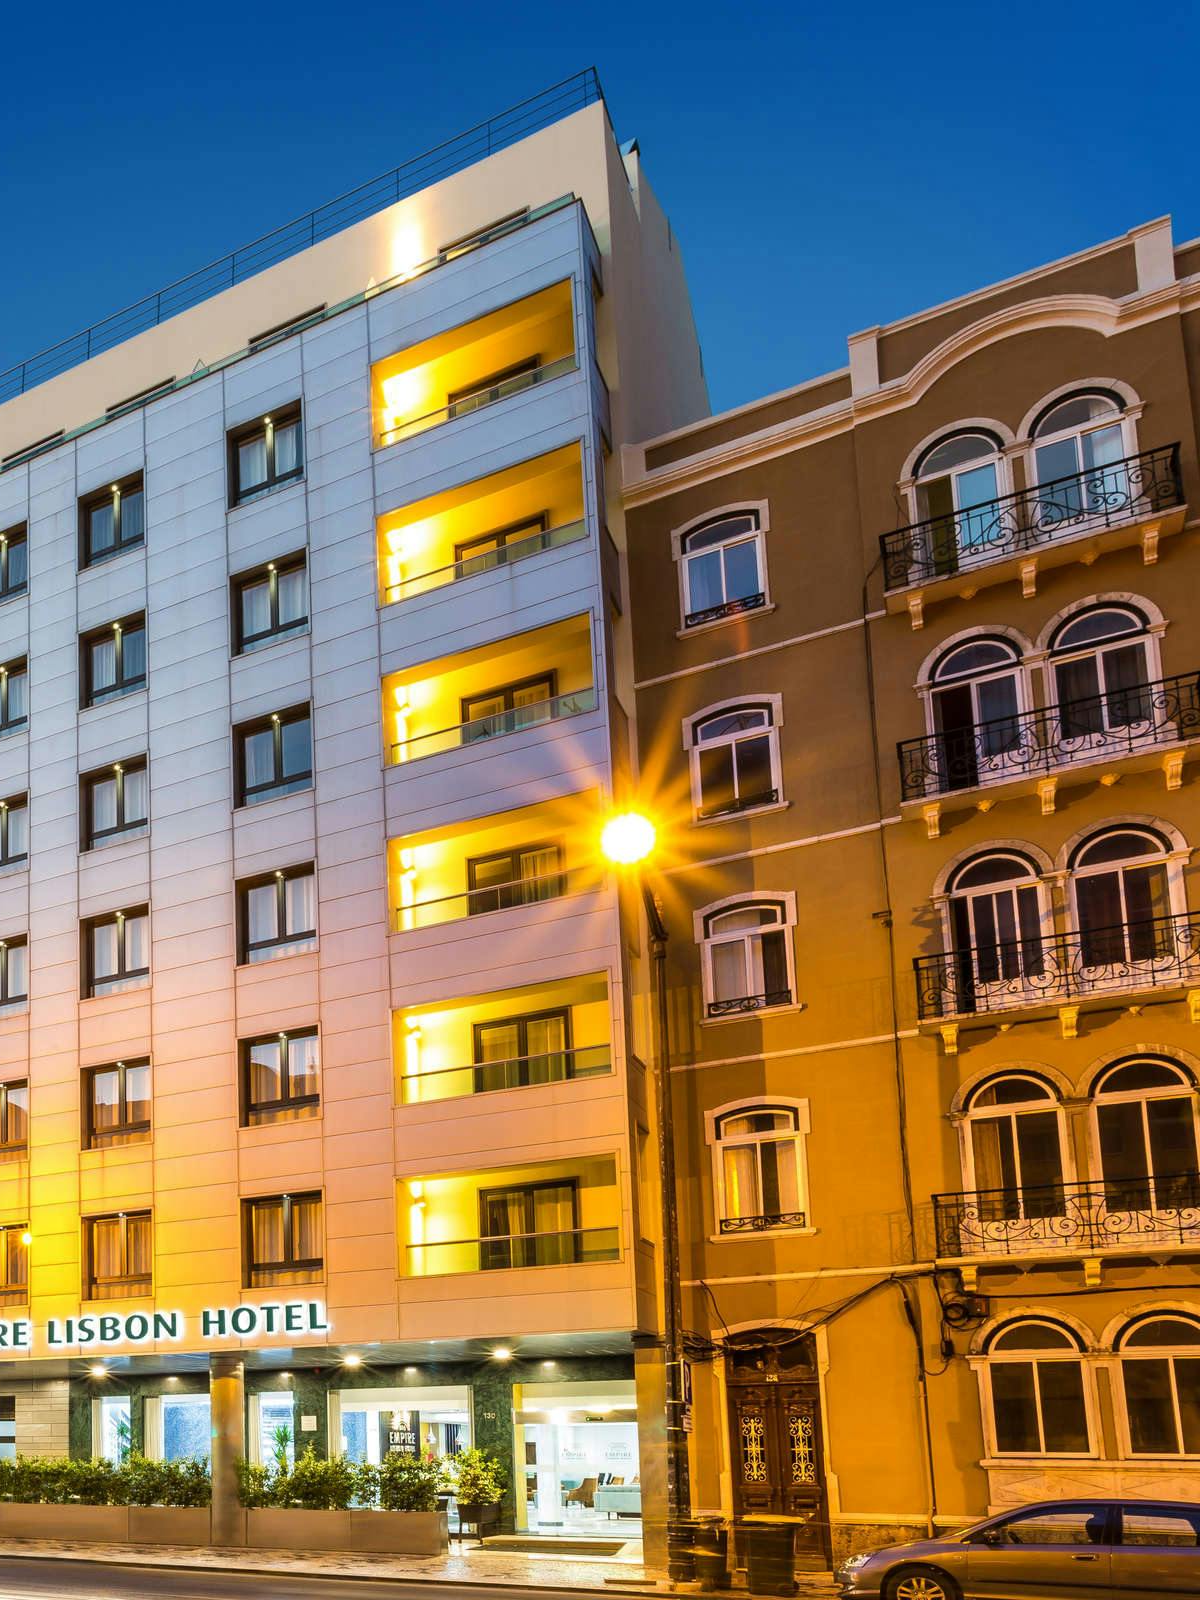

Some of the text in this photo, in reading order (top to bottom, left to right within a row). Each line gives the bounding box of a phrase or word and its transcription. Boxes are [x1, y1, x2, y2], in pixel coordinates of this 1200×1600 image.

[47, 1312, 178, 1344] LISBON
[202, 1303, 328, 1336] HOTEL
[389, 1431, 416, 1444] EMPIRE
